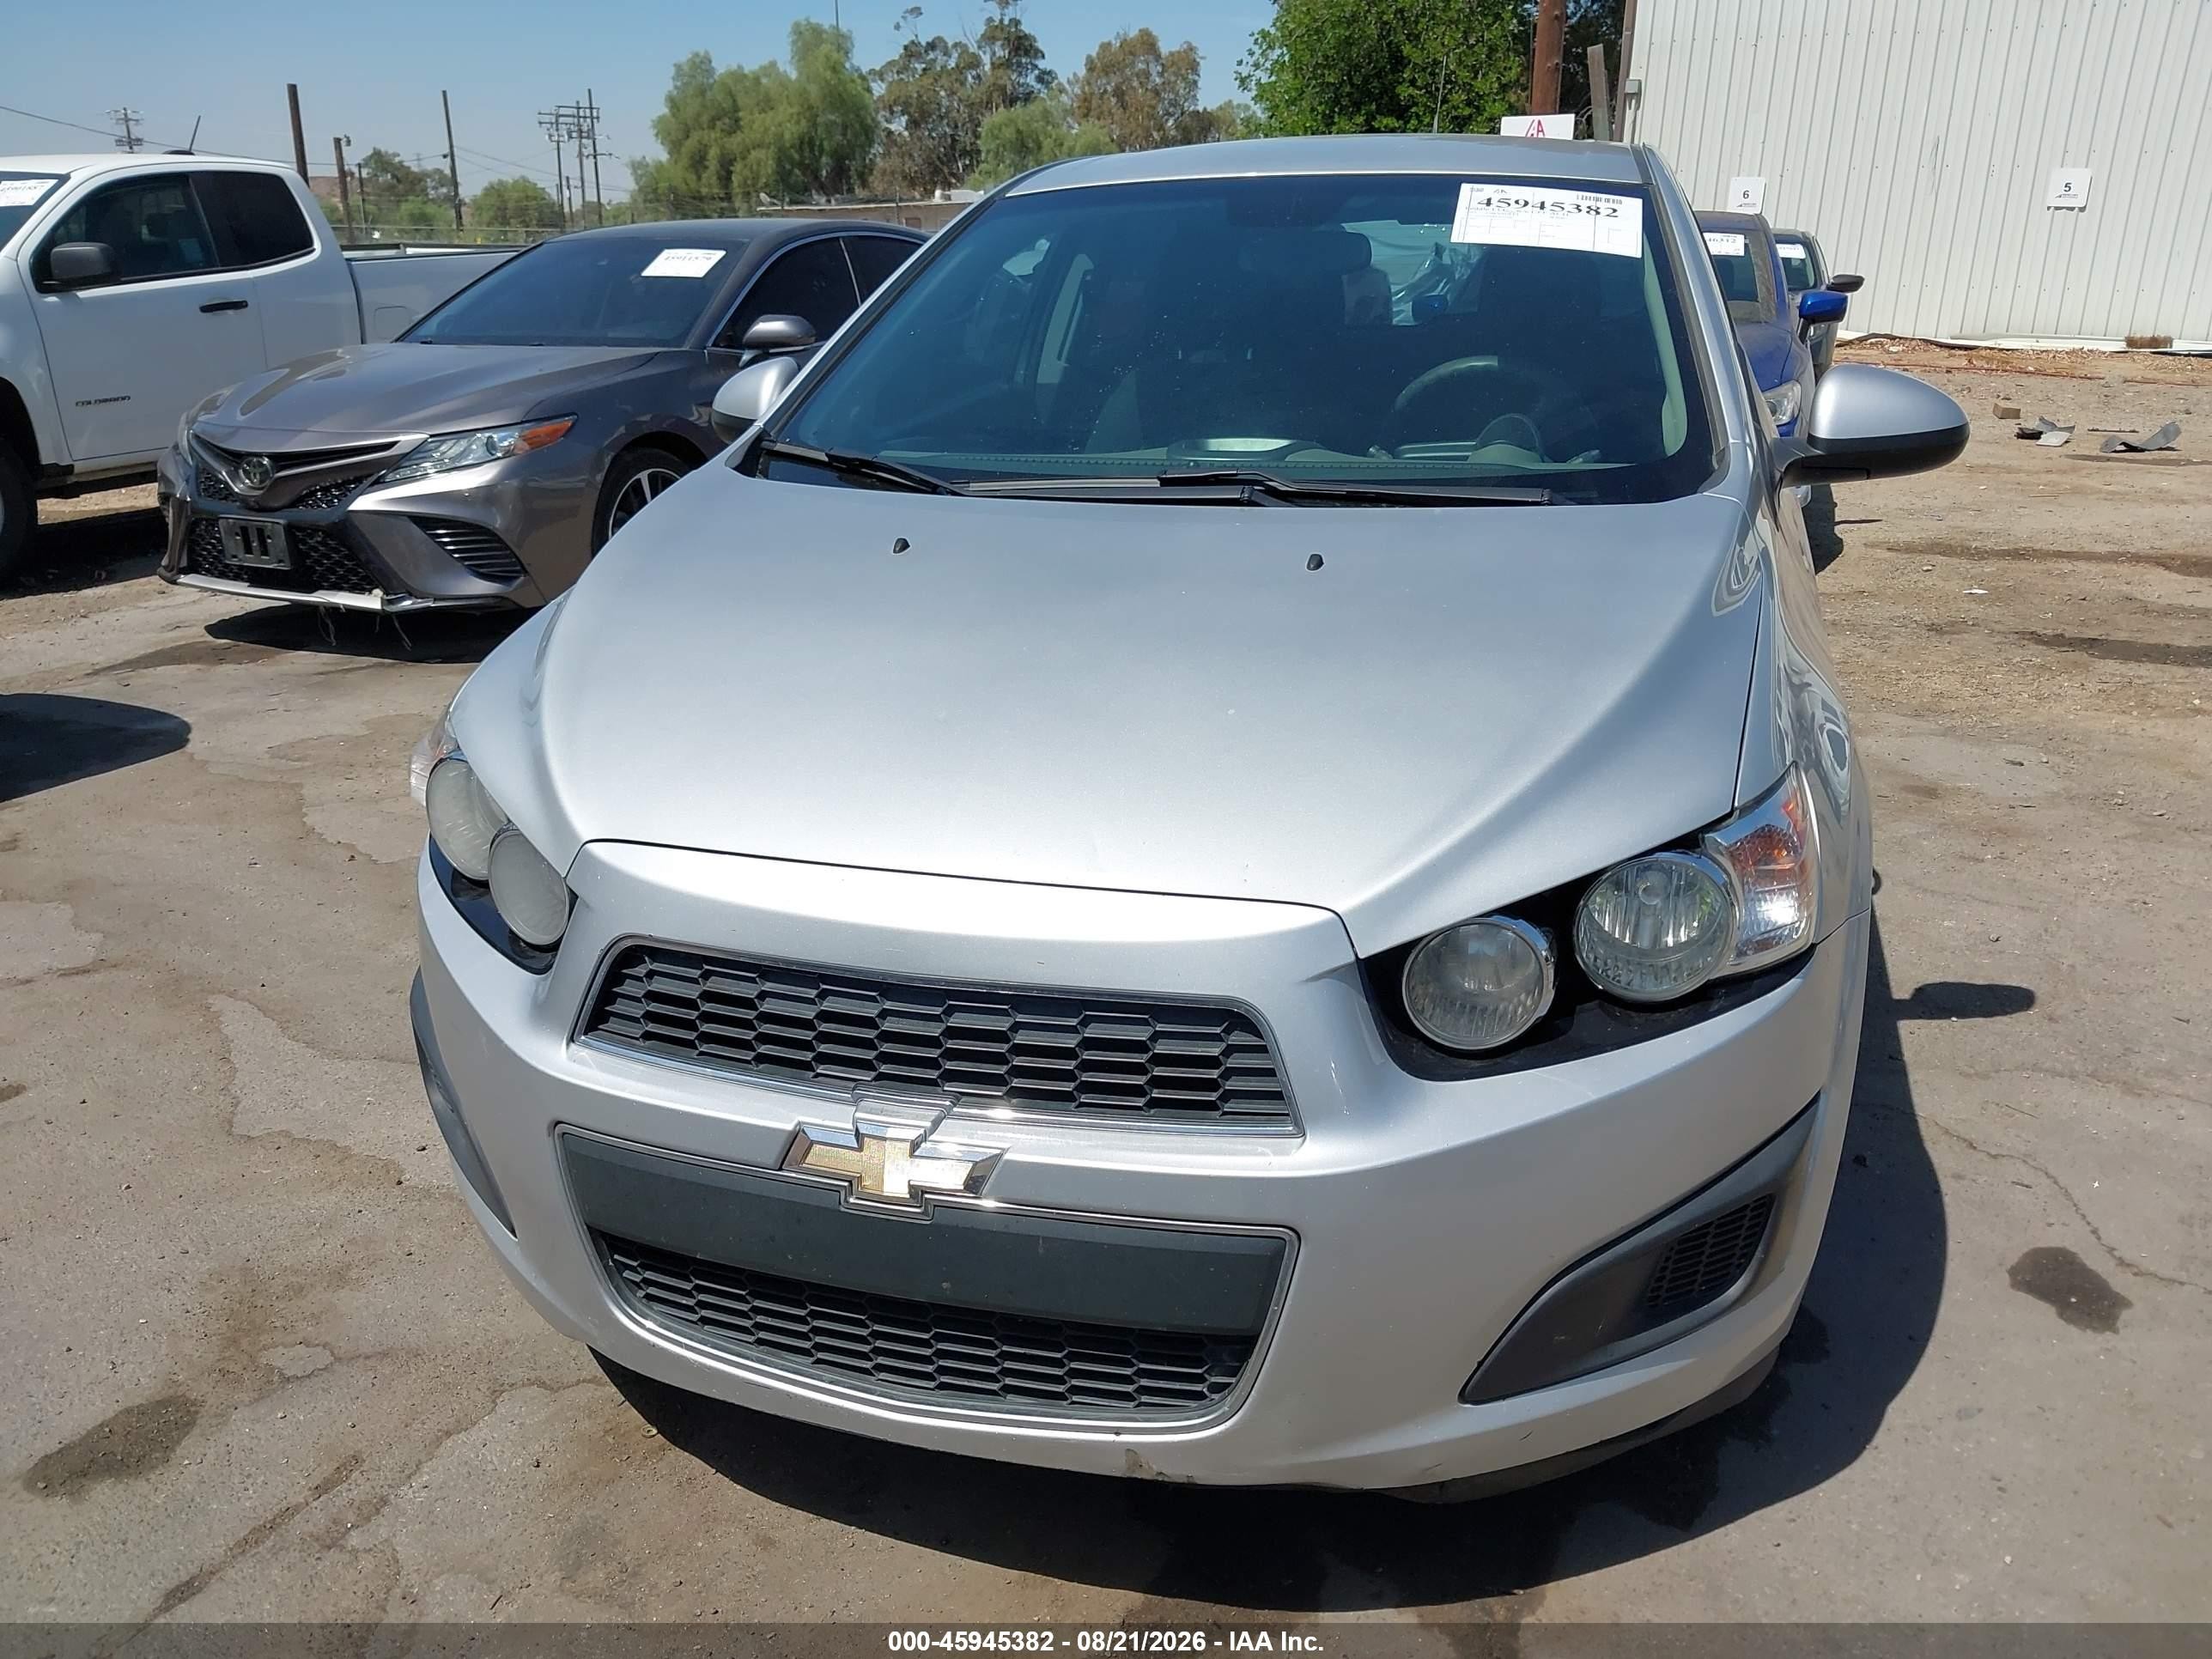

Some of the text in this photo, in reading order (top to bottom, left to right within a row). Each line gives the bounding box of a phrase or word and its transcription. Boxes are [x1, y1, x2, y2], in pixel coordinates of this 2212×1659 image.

[2063, 182, 2072, 192] 5
[1742, 189, 1750, 199] 6
[1476, 196, 1620, 218] 45945382
